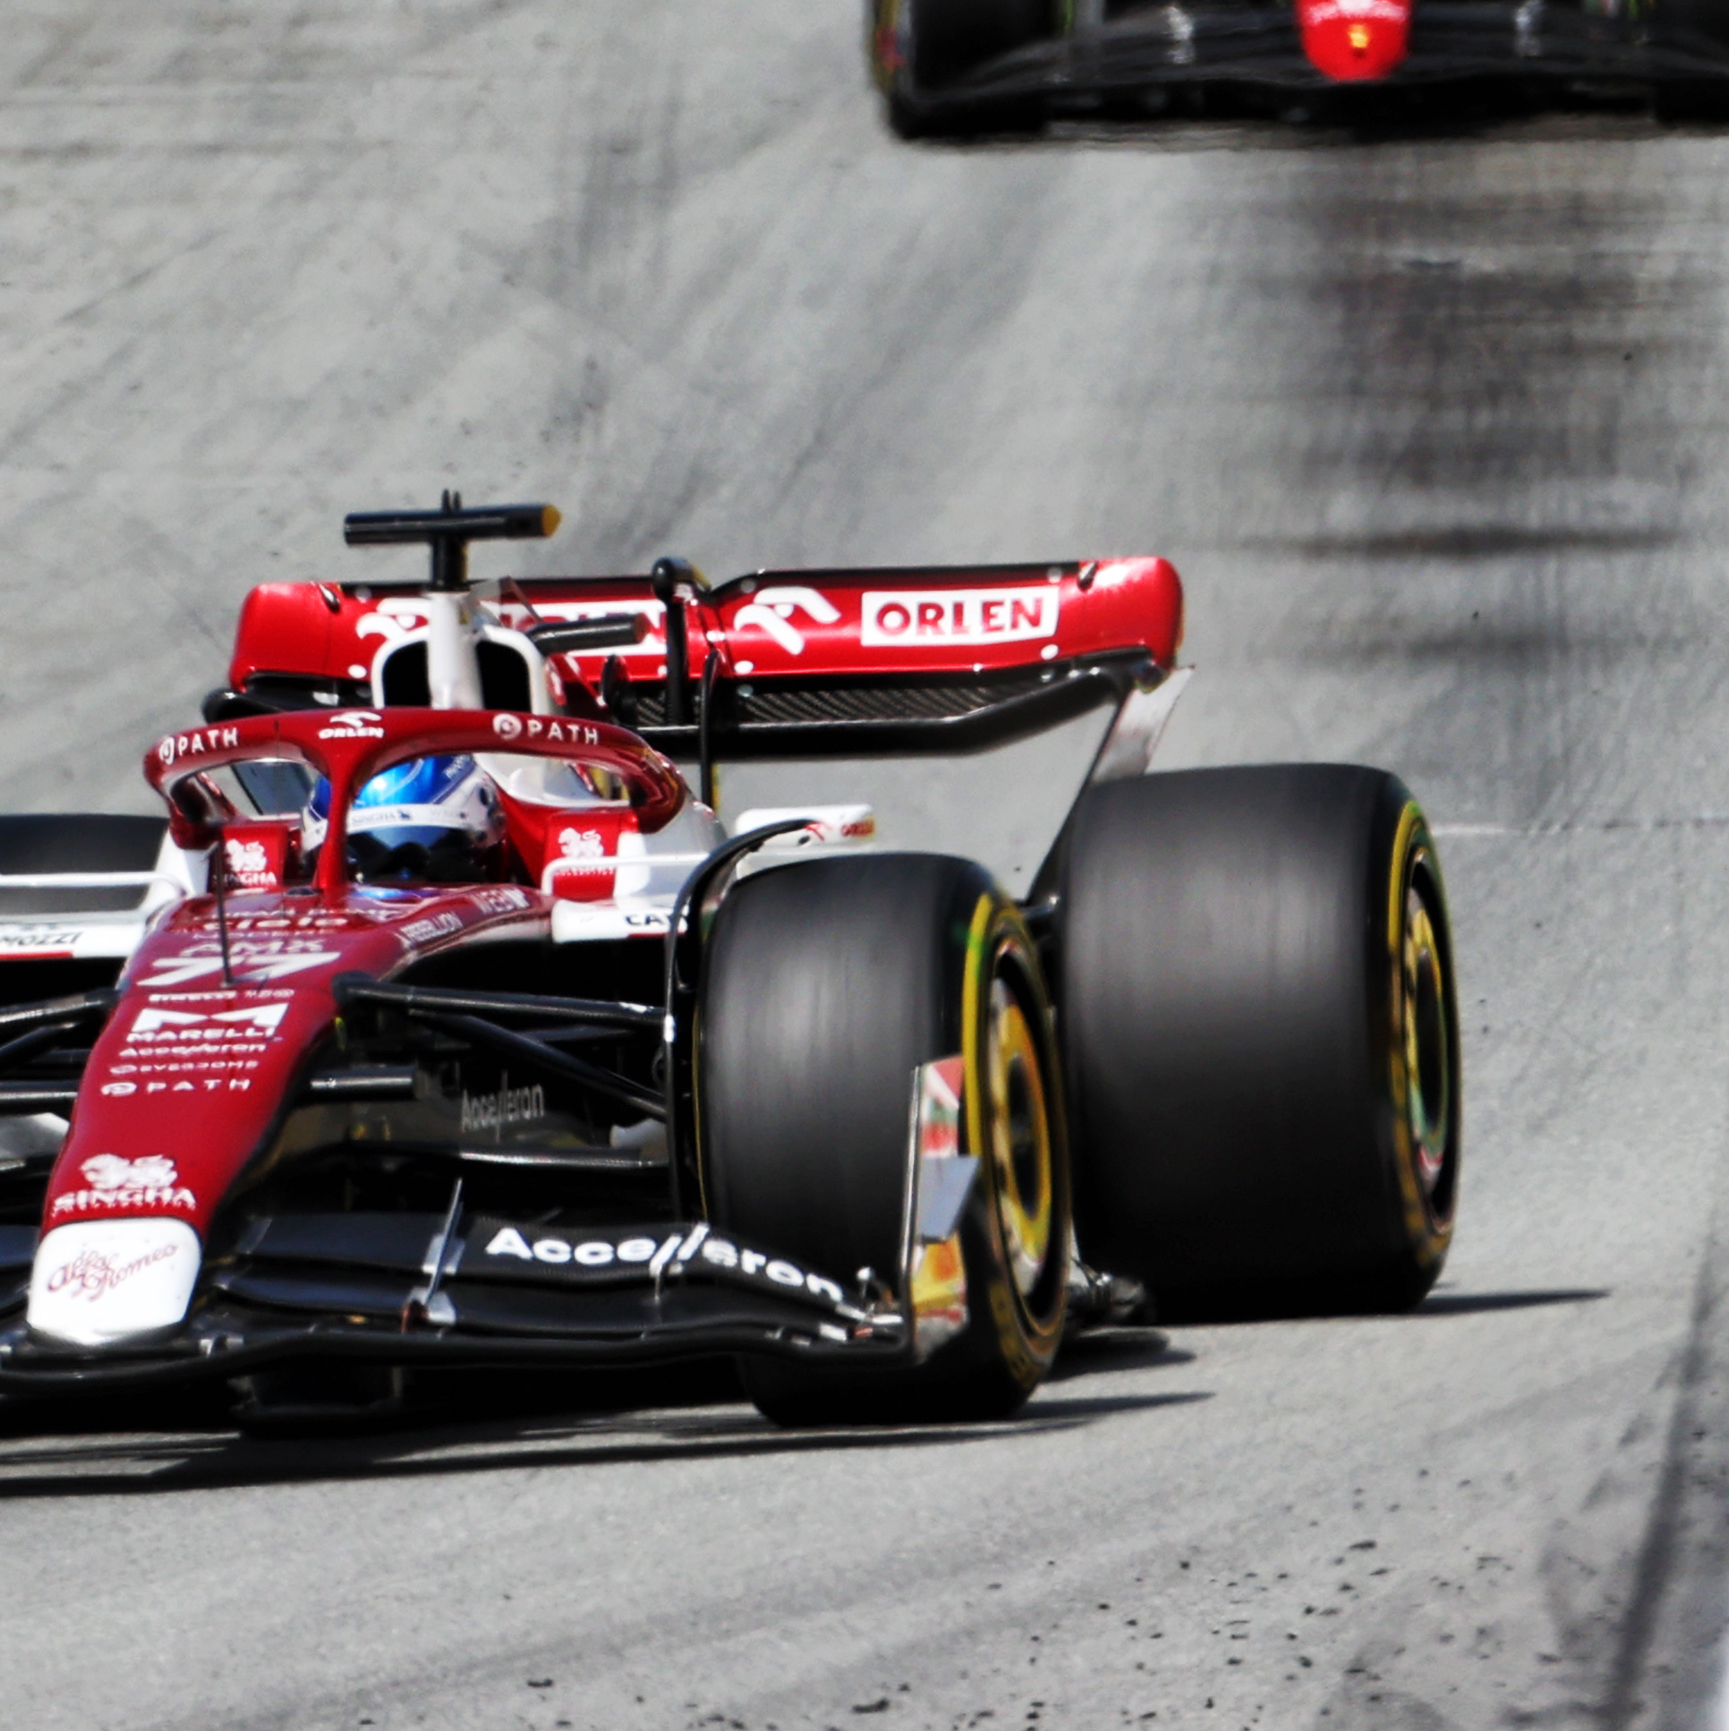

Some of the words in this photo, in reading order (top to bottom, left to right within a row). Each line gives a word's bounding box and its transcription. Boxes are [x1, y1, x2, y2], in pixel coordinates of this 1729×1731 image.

[874, 596, 1044, 637] ORLEN
[177, 727, 238, 756] PATH
[318, 727, 384, 739] ORLEN
[526, 719, 599, 746] PATH
[136, 951, 341, 986] 77
[126, 1027, 276, 1043] MARELLI
[146, 1078, 251, 1095] PATH
[53, 1187, 197, 1211] SINGHA
